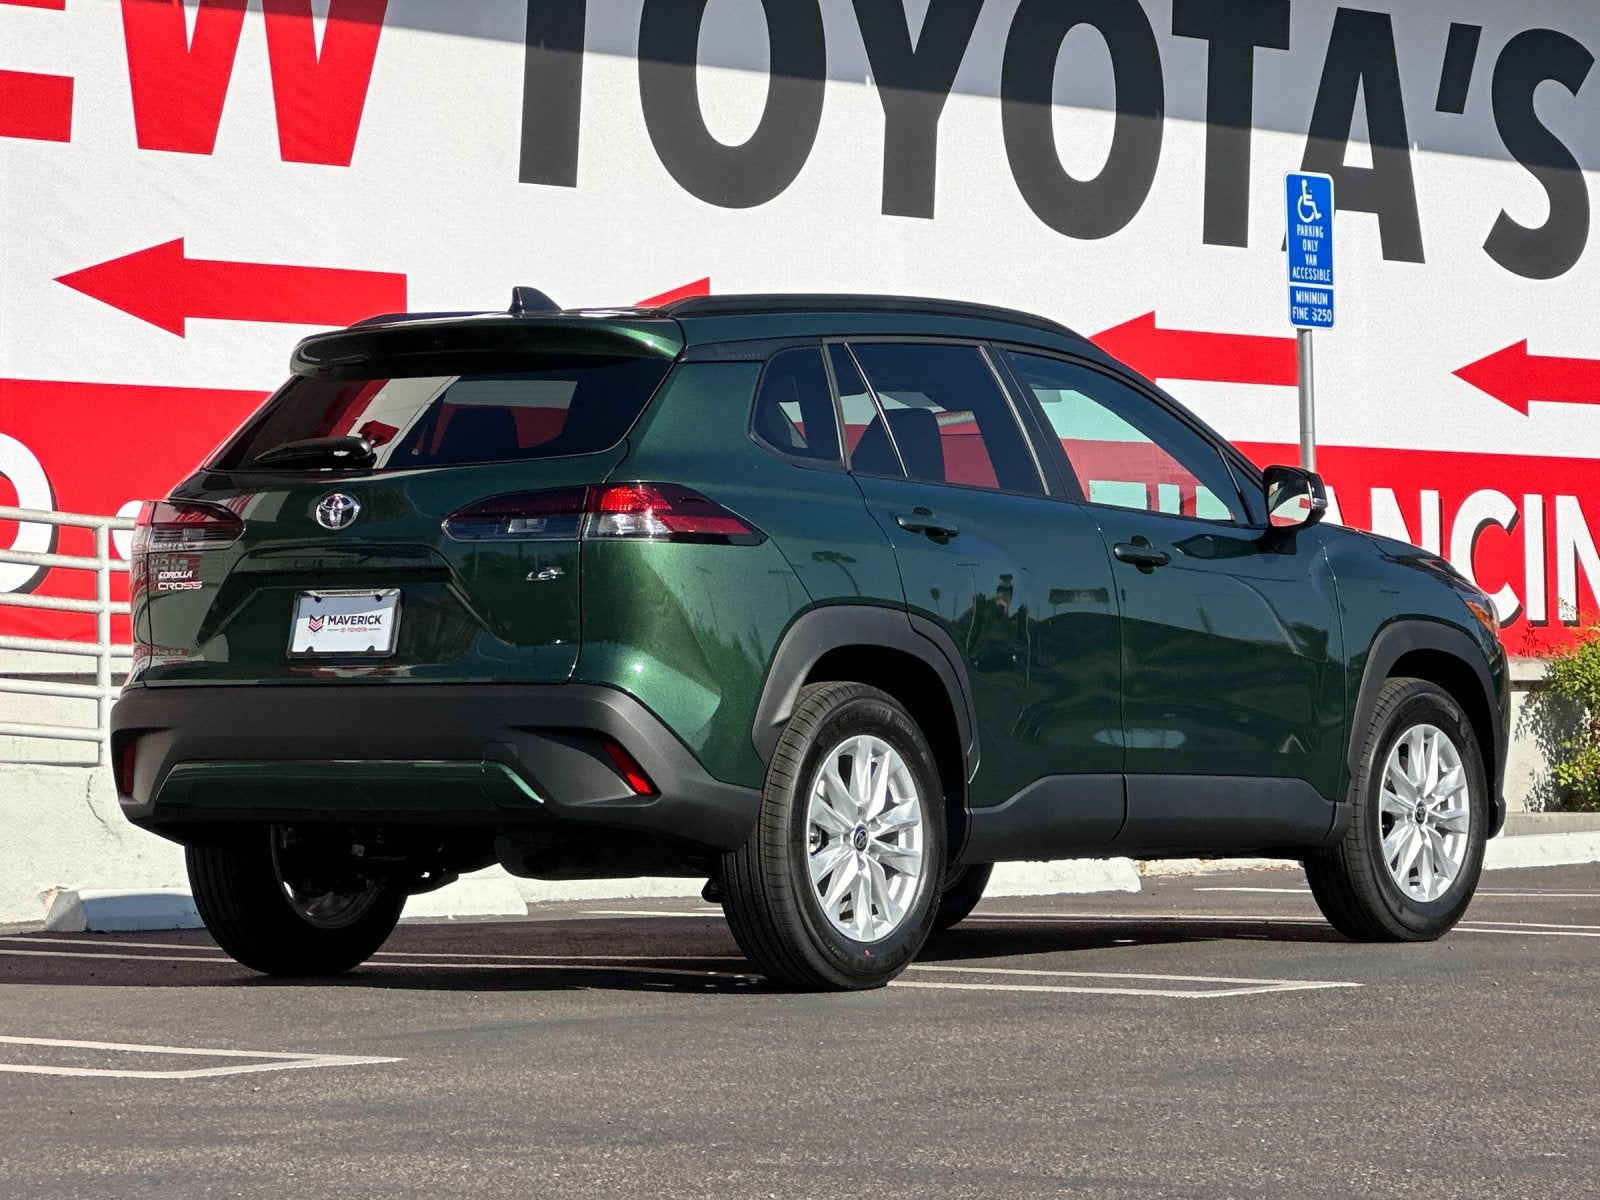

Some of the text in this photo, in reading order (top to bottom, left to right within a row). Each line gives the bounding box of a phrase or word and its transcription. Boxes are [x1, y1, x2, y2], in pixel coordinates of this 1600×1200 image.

[519, 0, 1596, 280] TOYOTA'S
[1297, 224, 1324, 238] PARKING
[1302, 239, 1319, 252] ONLY
[1305, 254, 1318, 266] VAN
[1292, 266, 1331, 282] ACCESSIBLE
[1295, 290, 1328, 305] MINIMUM
[1292, 307, 1332, 322] FINE $250
[158, 571, 193, 579] COROLLA
[157, 581, 203, 590] CROSS
[327, 614, 383, 626] MAVERICK
